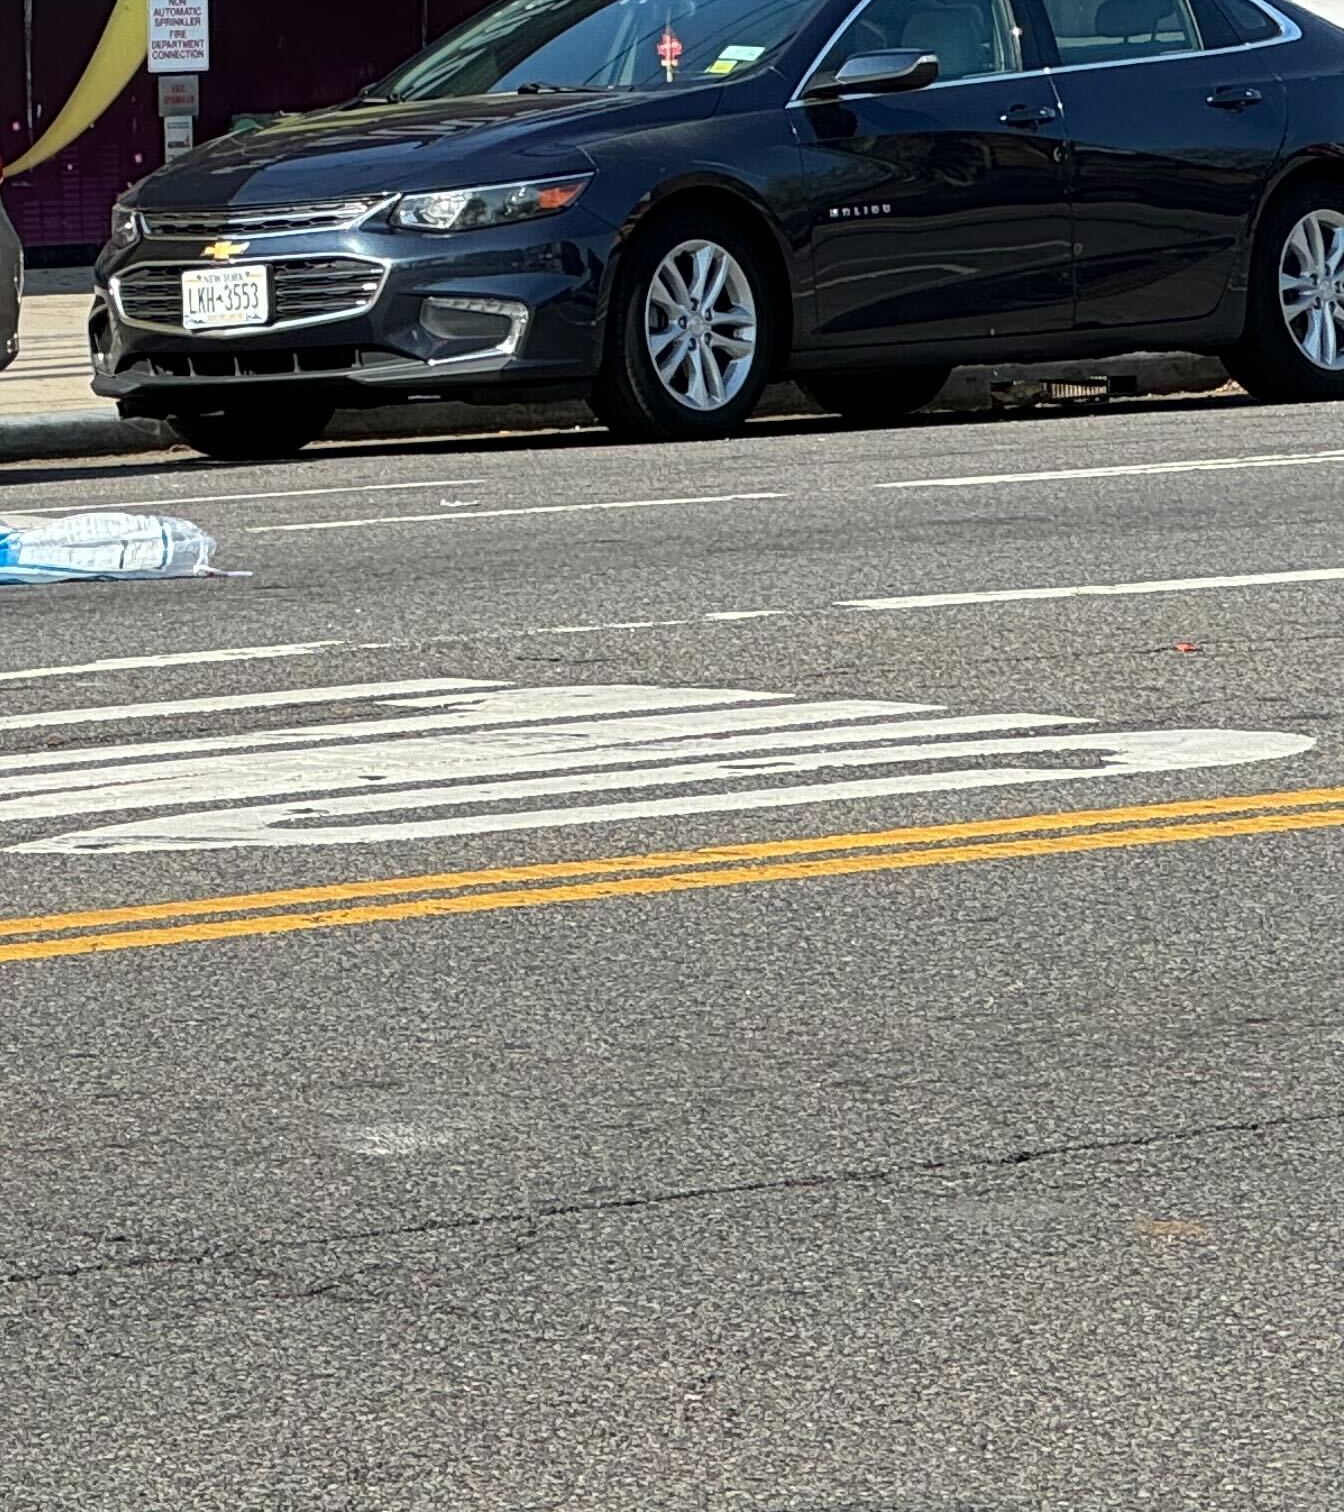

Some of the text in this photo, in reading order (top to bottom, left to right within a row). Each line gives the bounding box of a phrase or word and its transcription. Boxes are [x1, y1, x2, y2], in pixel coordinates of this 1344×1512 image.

[153, 6, 202, 17] AUTOMATIC
[154, 17, 201, 27] SPRINKLER
[169, 29, 186, 39] FIRE
[151, 39, 204, 50] DEPARTMENT
[152, 49, 204, 61] CONNECTION
[202, 272, 244, 284] NEW YORK
